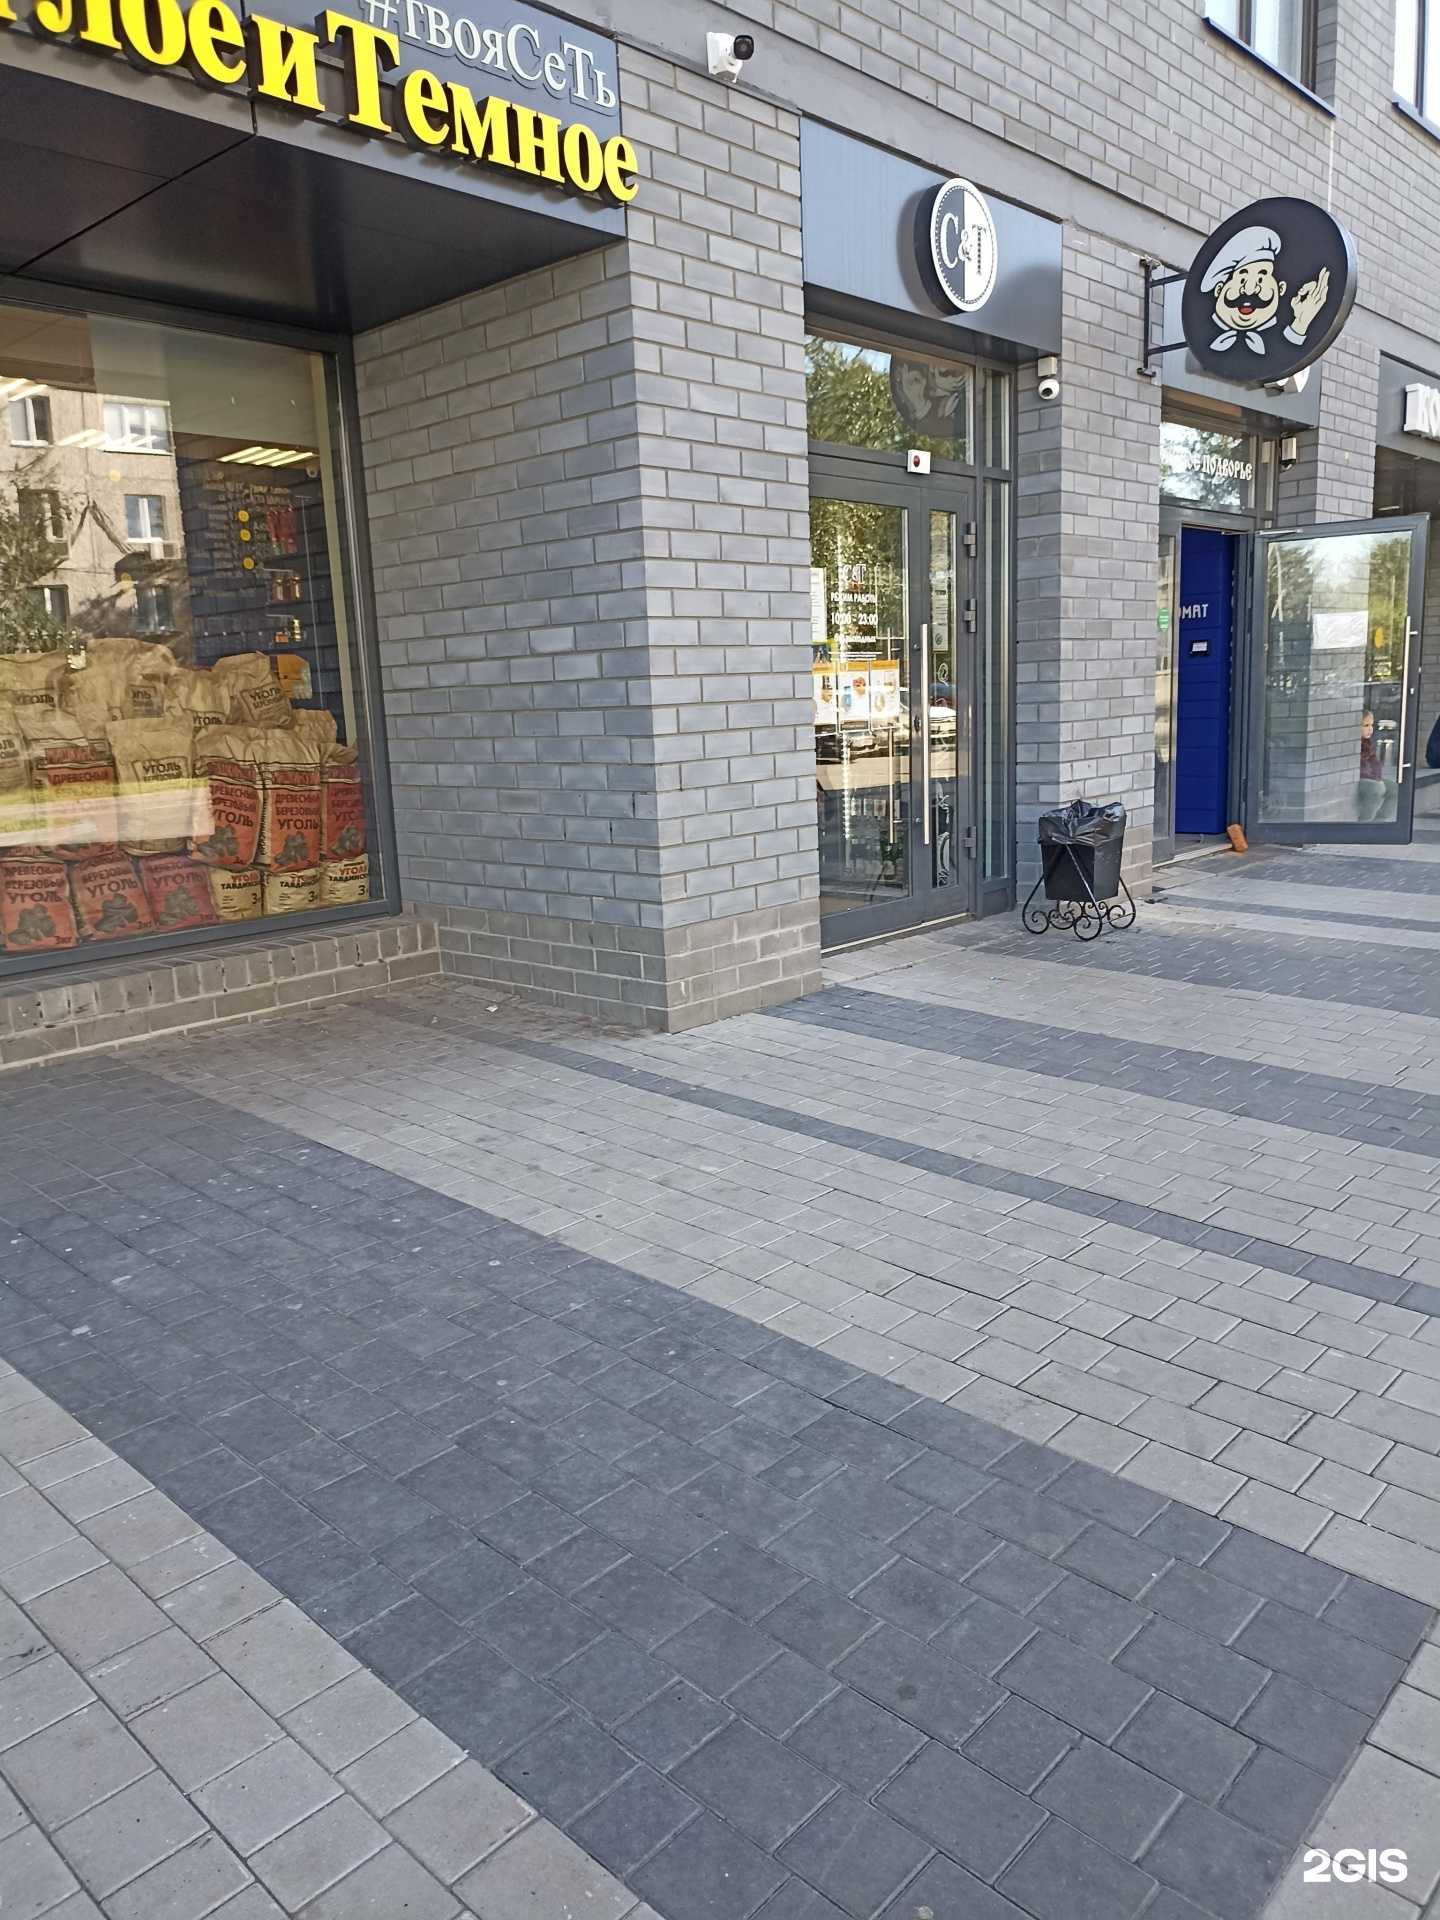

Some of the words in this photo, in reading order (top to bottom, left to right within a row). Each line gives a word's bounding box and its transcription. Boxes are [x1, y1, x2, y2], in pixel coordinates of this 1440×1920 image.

[858, 612, 878, 625] 23:00
[142, 762, 182, 775] УГОЛЬ
[278, 818, 320, 830] УГОЛЬ
[86, 878, 138, 898] УГОЛЬ
[8, 891, 63, 904] УГОЛЬ
